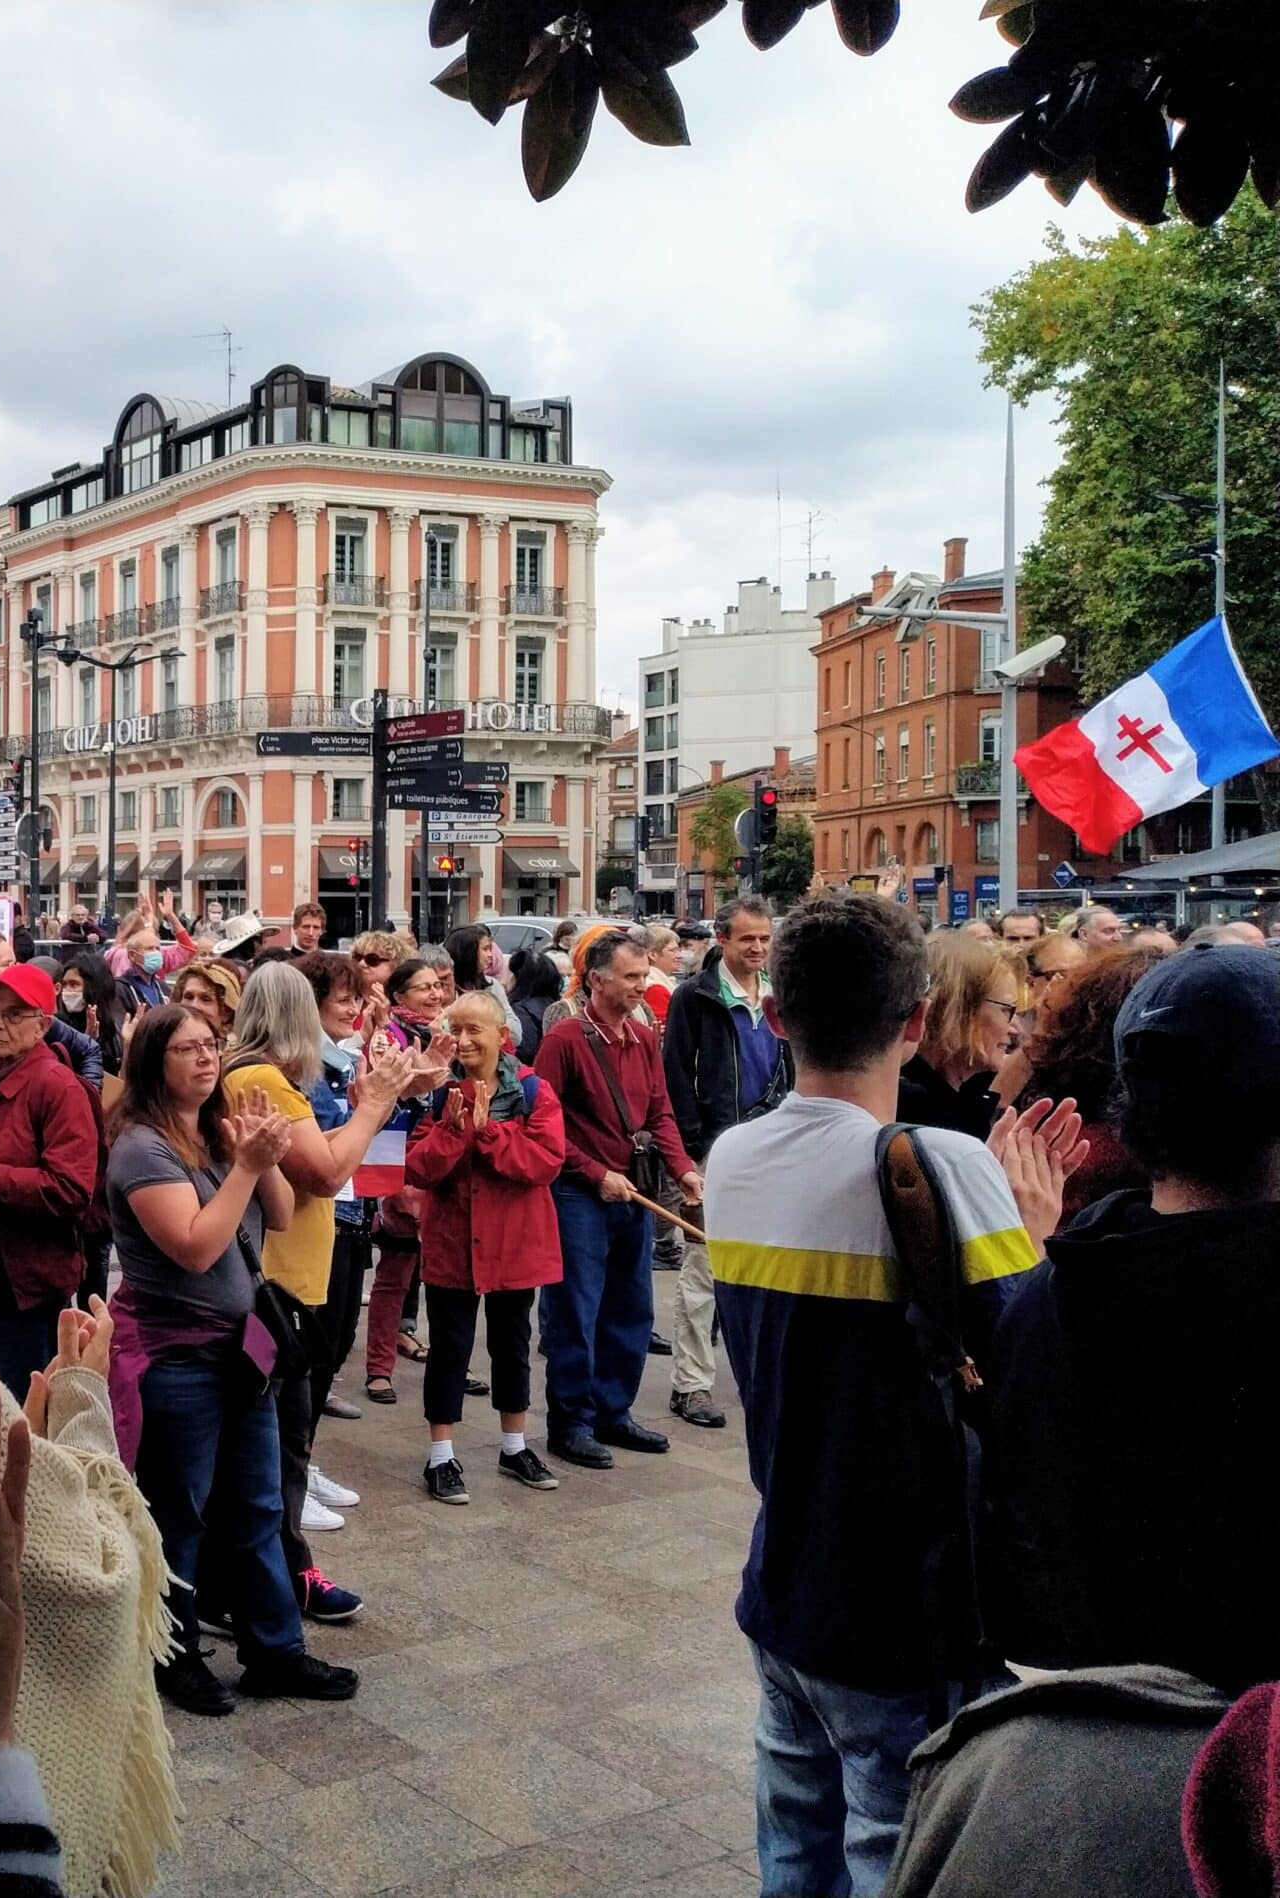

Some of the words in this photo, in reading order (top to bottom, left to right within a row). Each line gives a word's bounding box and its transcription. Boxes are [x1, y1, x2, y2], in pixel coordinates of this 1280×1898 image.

[468, 702, 563, 732] HOTEL
[63, 722, 101, 751] CITIZ
[311, 736, 330, 746] place
[330, 735, 350, 744] Victor
[351, 736, 369, 746] Hugo
[406, 794, 434, 804] toilettes
[435, 795, 469, 806] publiques
